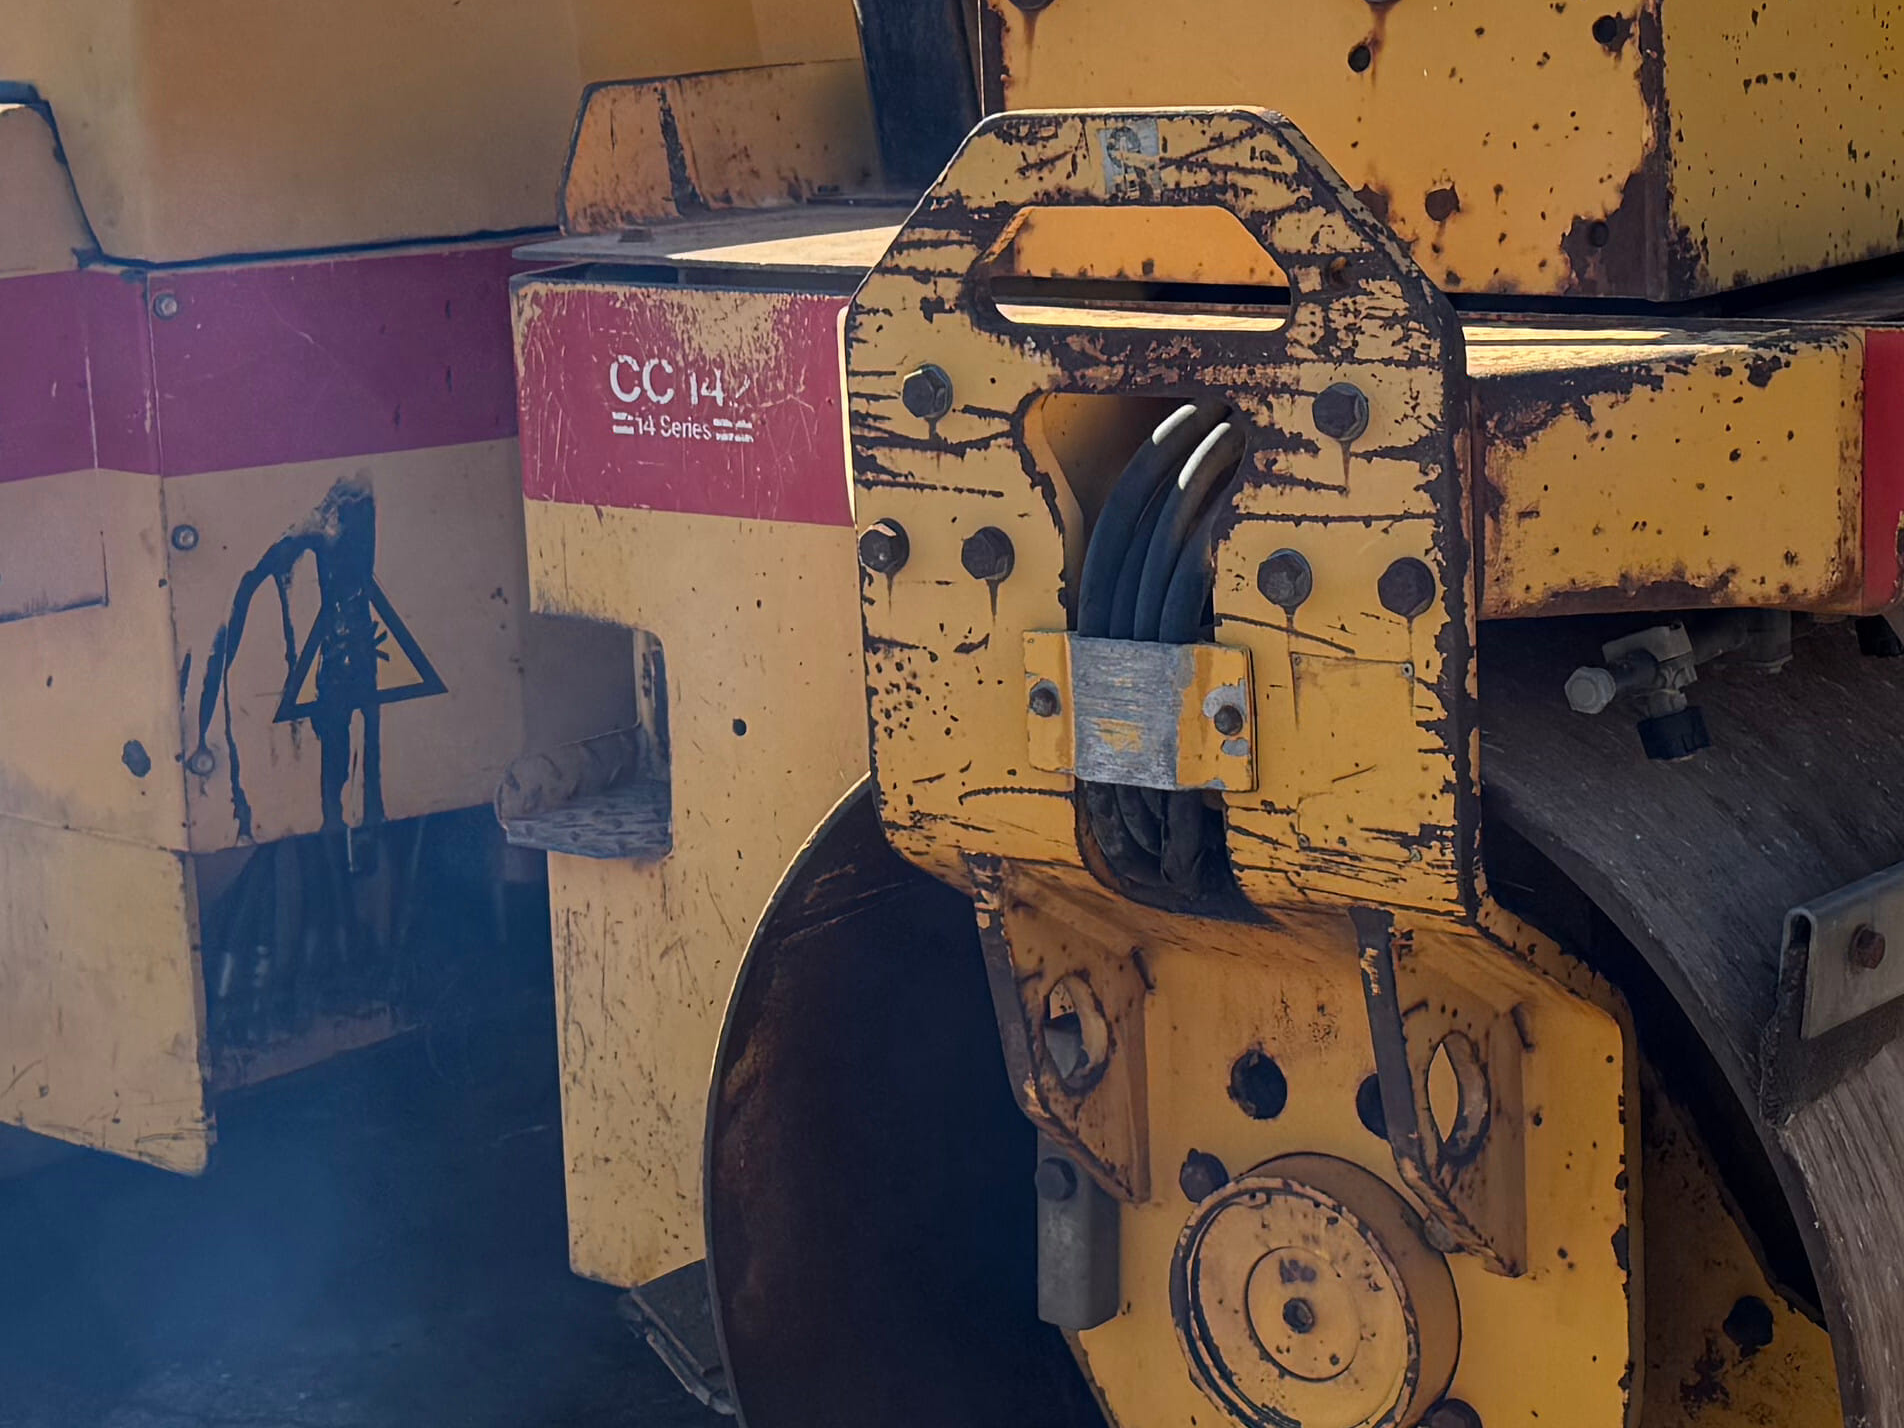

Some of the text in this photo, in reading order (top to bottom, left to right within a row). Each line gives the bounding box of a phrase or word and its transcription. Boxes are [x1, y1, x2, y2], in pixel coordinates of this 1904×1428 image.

[609, 354, 675, 405] CC
[636, 414, 712, 441] 14 Series
